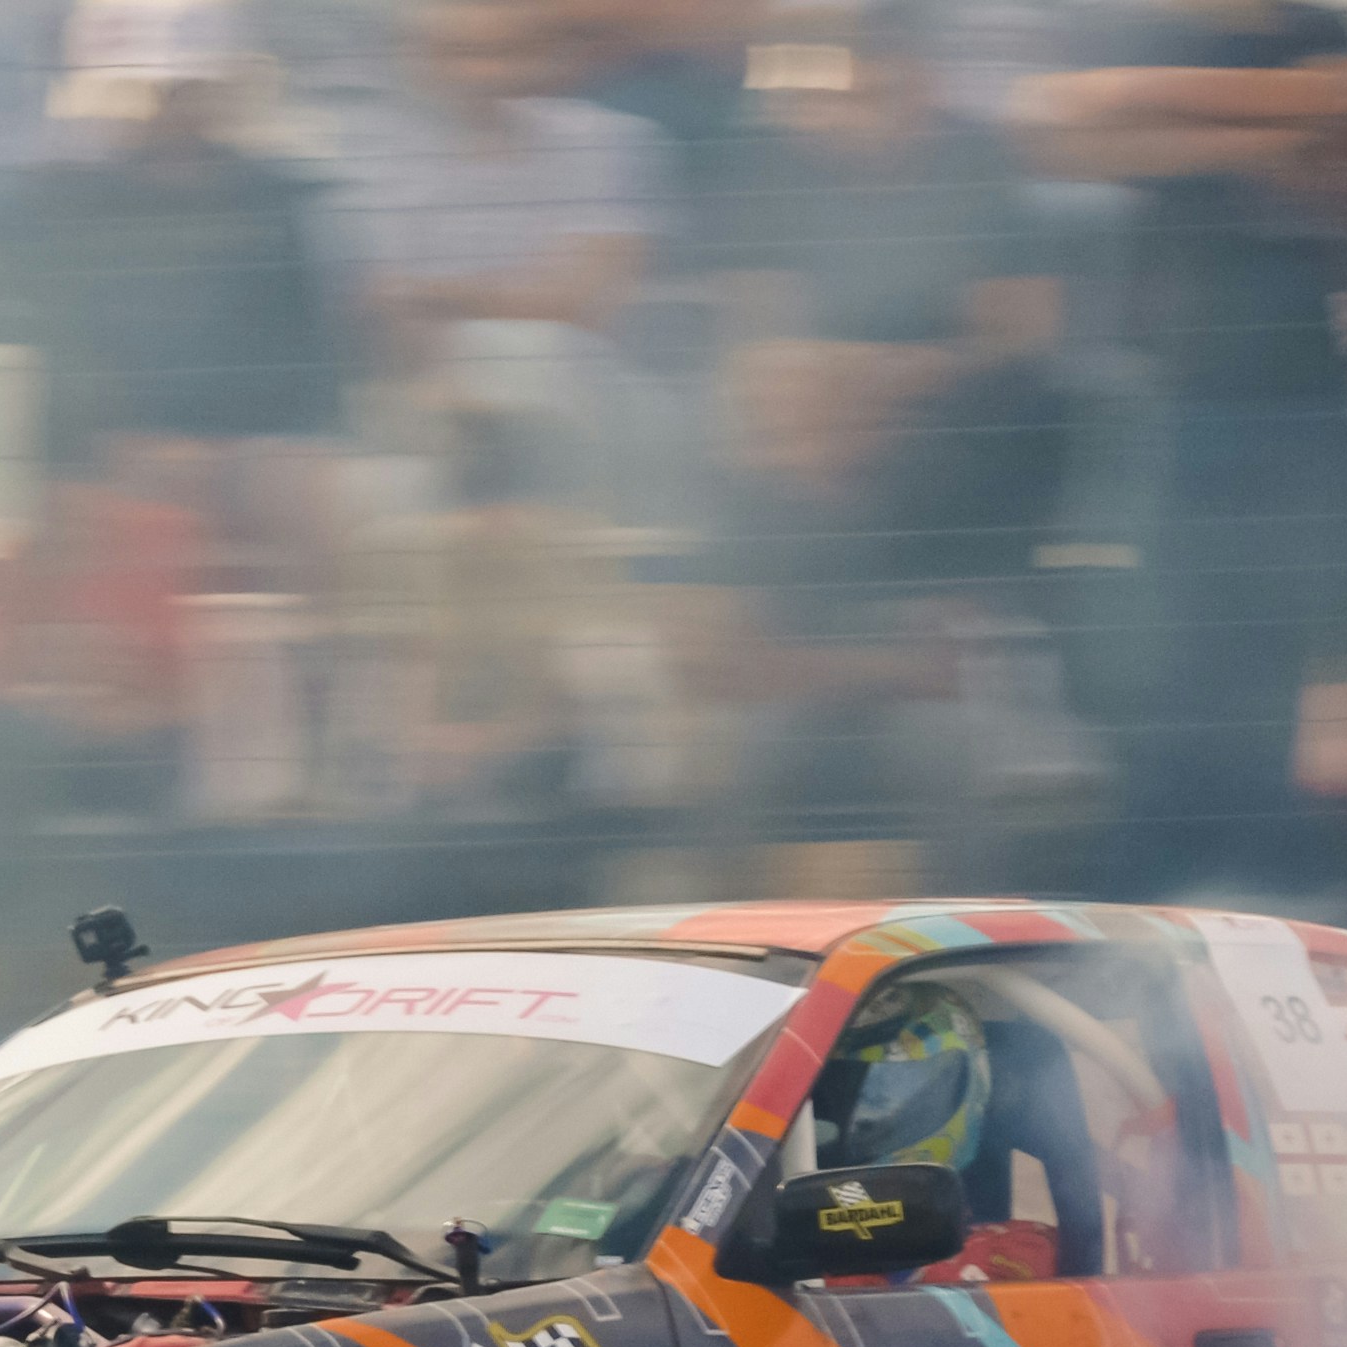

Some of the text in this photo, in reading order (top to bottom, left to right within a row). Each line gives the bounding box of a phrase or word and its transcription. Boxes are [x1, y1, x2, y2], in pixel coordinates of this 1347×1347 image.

[98, 982, 579, 1031] KING DRIFT
[1260, 995, 1323, 1044] 38
[825, 1206, 900, 1225] BARDAHL
